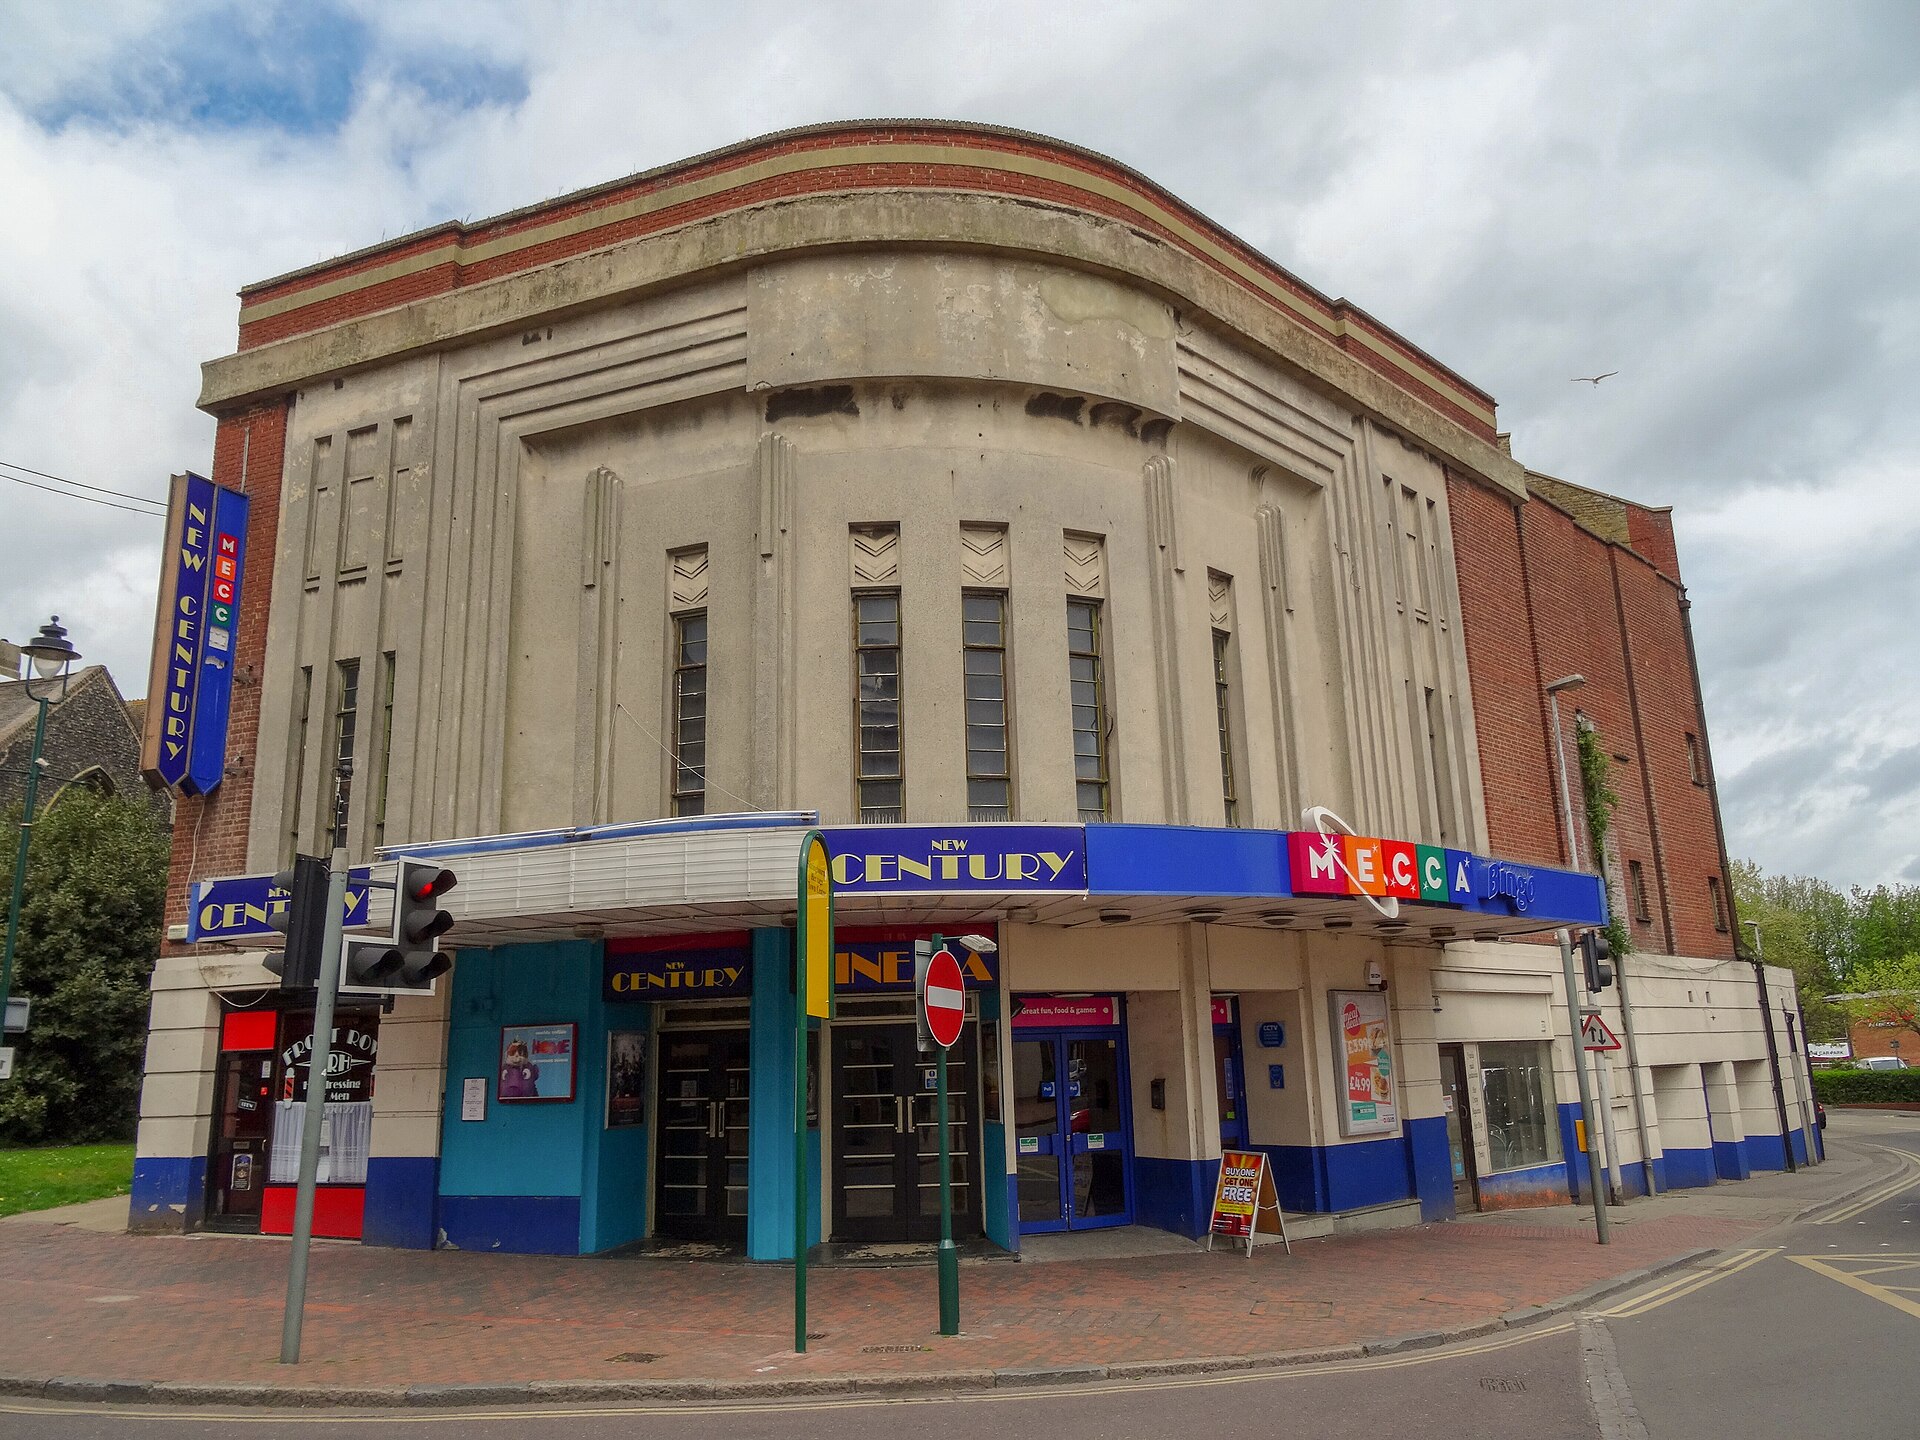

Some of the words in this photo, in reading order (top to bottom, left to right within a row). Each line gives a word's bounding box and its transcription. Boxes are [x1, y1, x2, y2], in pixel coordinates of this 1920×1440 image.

[181, 502, 206, 573] NEW
[166, 595, 197, 761] CENTURY
[931, 839, 968, 851] NEW
[831, 850, 1074, 884] CENTURY
[1308, 845, 1471, 893] MECCA
[1487, 861, 1536, 912] Bingo
[200, 888, 366, 931] CENTY
[612, 965, 744, 992] CENTURY
[665, 961, 685, 970] NEW
[834, 950, 993, 984] INEA
[1021, 1007, 1040, 1015] Great
[1040, 1006, 1053, 1015] fun,
[1054, 1006, 1069, 1014] food
[1069, 1006, 1075, 1014] &
[1075, 1006, 1096, 1015] games
[282, 1027, 340, 1066] FROT
[329, 1091, 350, 1101] Men
[1349, 1076, 1371, 1092] £4.99
[1224, 1177, 1238, 1186] GET
[1239, 1178, 1253, 1187] ONE
[1225, 1167, 1241, 1177] BUY
[1240, 1168, 1255, 1177] ONE
[1221, 1186, 1252, 1202] FREE
